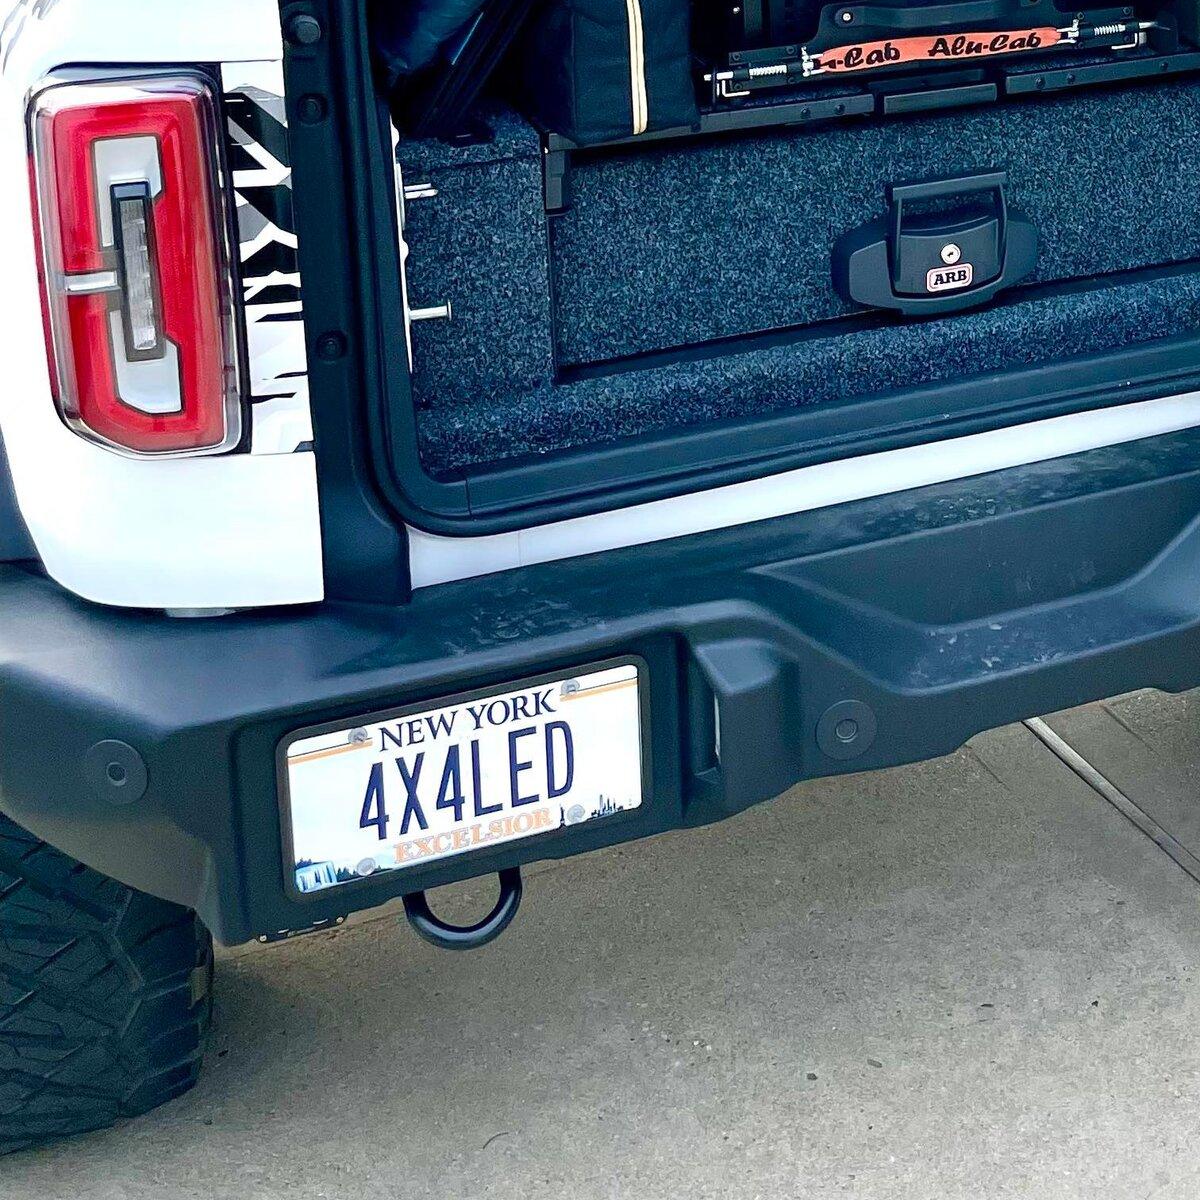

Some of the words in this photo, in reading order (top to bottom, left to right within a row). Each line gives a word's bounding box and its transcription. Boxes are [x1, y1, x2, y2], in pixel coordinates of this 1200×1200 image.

[928, 32, 1041, 56] Alu-Cab
[933, 269, 967, 286] ARB
[379, 710, 458, 752] NEW
[466, 688, 557, 731] YORK
[359, 720, 575, 841] 4X4LED
[393, 807, 553, 865] EXCELSIOR
